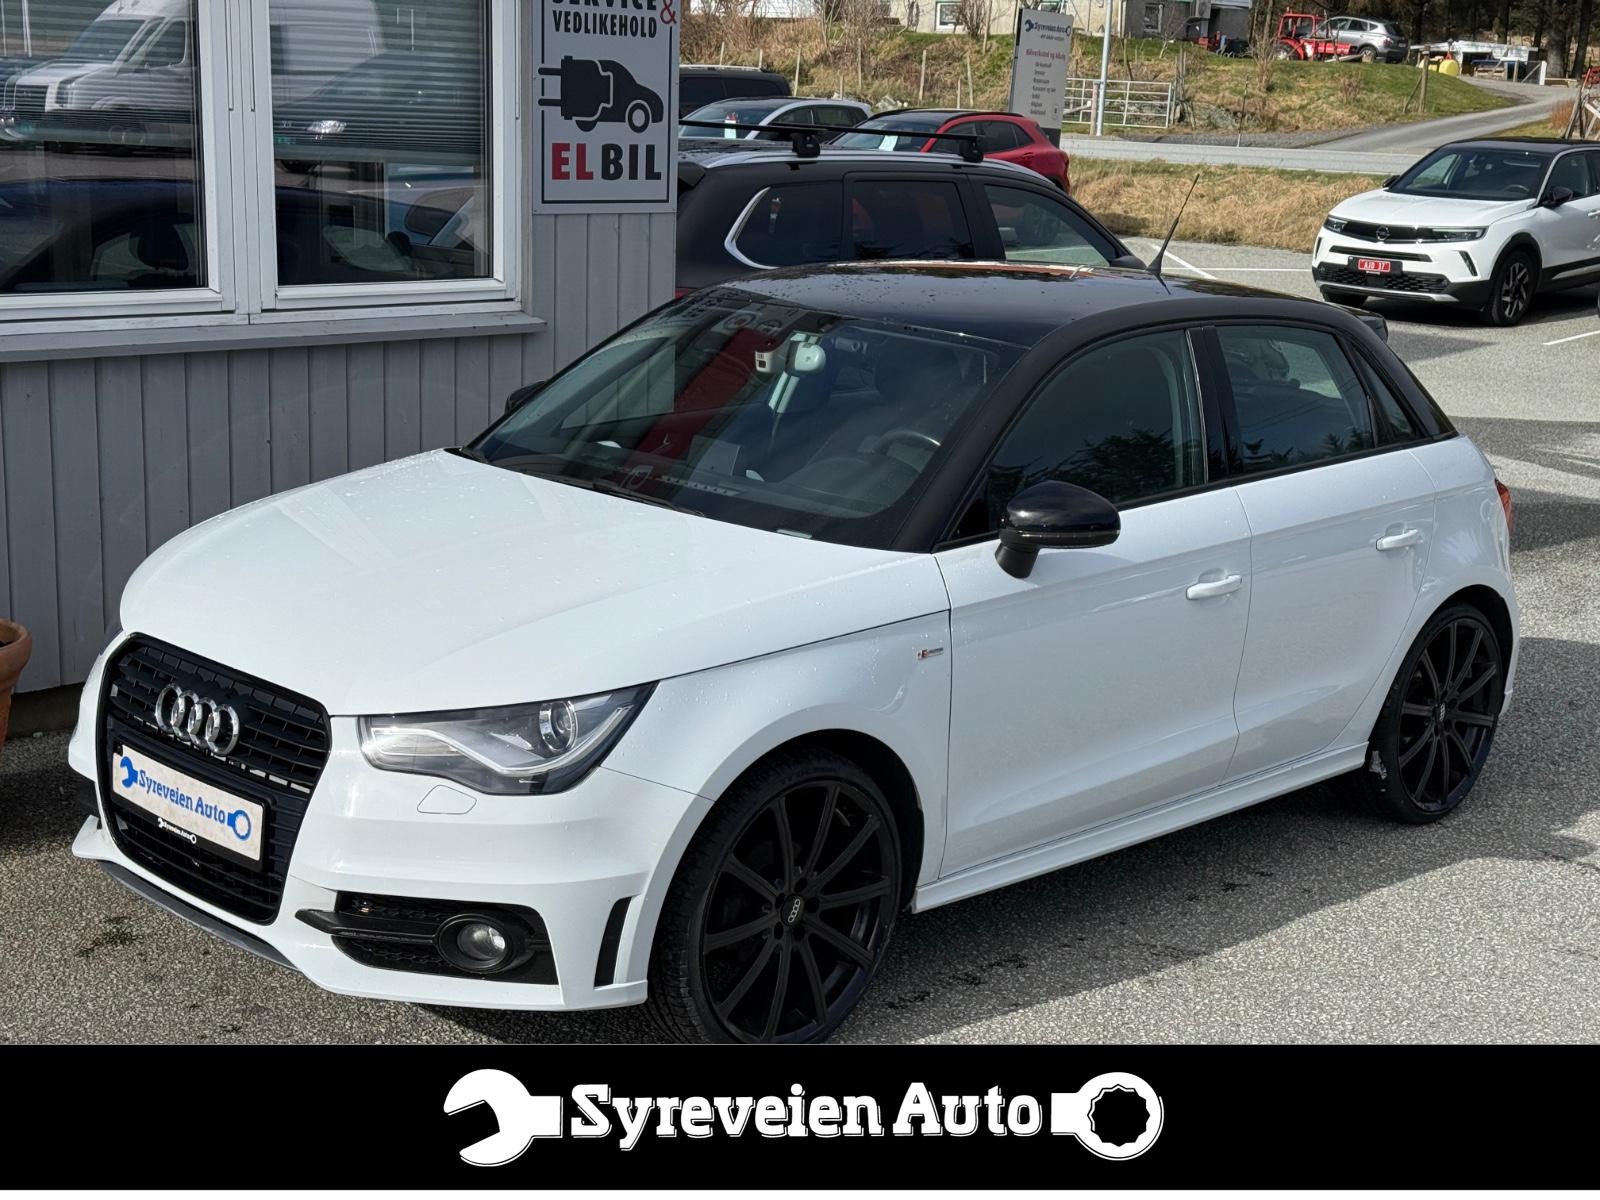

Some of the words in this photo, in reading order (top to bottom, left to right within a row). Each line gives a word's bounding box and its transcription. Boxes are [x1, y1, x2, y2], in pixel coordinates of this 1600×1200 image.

[552, 10, 657, 38] VEDLIKEHOLD
[551, 142, 662, 181] ELBIL
[139, 769, 193, 811] Syreveien
[195, 796, 226, 824] Auto
